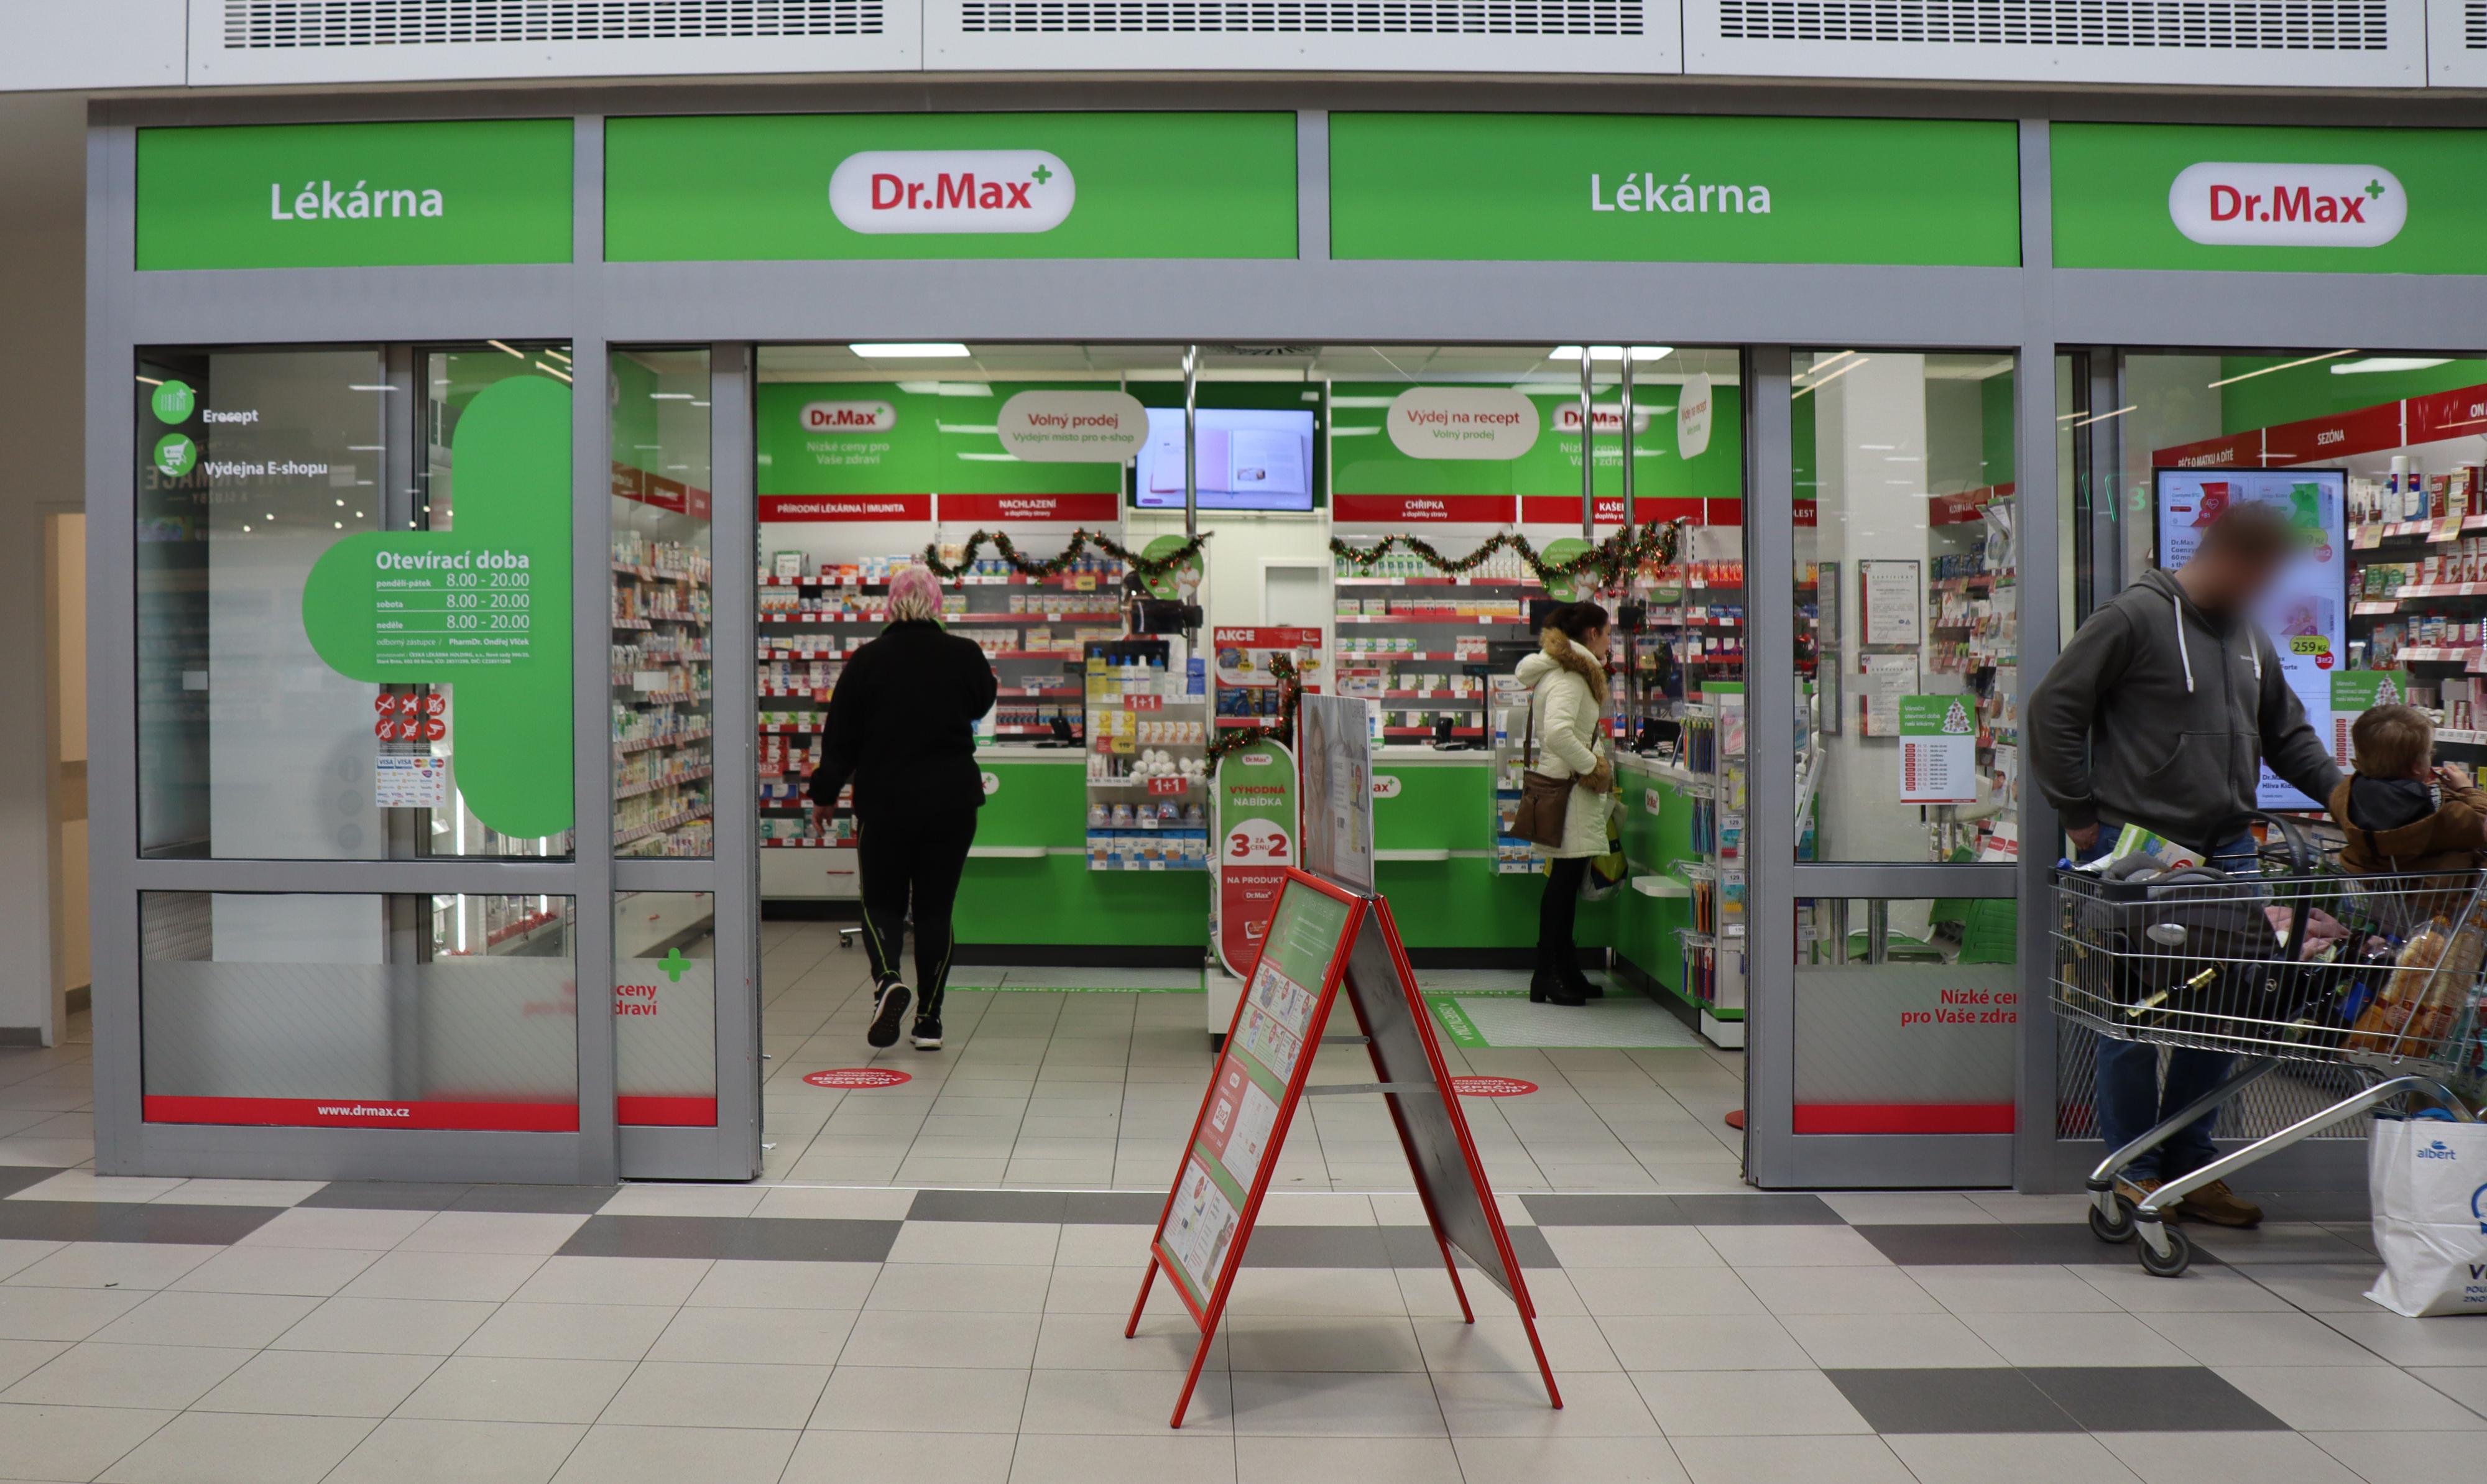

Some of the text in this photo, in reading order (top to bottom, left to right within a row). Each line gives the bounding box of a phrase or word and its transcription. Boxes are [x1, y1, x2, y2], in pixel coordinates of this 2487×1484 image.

[271, 181, 443, 219] Lékárna
[1592, 173, 1771, 213] Lékárna
[2470, 403, 2485, 417] ON
[1028, 413, 1119, 429] Volný prodej
[1407, 410, 1520, 426] Výdej na recept
[1081, 435, 1098, 443] pro
[1100, 432, 1134, 443] e-shop
[1433, 429, 1495, 441] Volný prodej
[2317, 430, 2345, 445] SEZÓNA
[841, 443, 867, 453] ceny
[870, 443, 890, 453] pro
[2197, 452, 2215, 467] MATKU
[205, 461, 328, 479] Výdejna E-shopu
[777, 502, 905, 513] PŘÍRODNÍ LÉKÁRNA IMUNITA
[999, 499, 1056, 509] NACHLAZENÍ
[1405, 499, 1444, 509] CHŘIPKA
[376, 550, 530, 569] Otevírací doba
[376, 579, 431, 588] pondělí-pátek
[446, 573, 477, 586] 8.00
[490, 573, 530, 586] 20.00
[376, 600, 404, 608] sobota
[446, 594, 477, 607] 8.00
[490, 594, 530, 607] 20.00
[376, 621, 404, 629] neděle
[446, 615, 477, 629] 8.00
[490, 615, 530, 629] 20.00
[376, 638, 405, 647] odborný
[406, 638, 436, 647] zástupce
[484, 638, 508, 647] Ondřej
[510, 638, 530, 646] Vlček
[1216, 630, 1255, 642] AKCE
[2293, 642, 2316, 652] 259
[1130, 696, 1155, 709] 1+1
[1155, 779, 1179, 792] 1+1
[1230, 785, 1286, 795] VÝHODNÁ
[1234, 795, 1282, 806] NABÍDKA
[1230, 833, 1288, 857] 3 2
[617, 985, 657, 1000] ceny
[1941, 989, 1990, 1004] Nízké
[1901, 1011, 1931, 1027] pro
[1935, 1008, 1975, 1023] Vaše
[318, 1105, 410, 1117] www.drmax.cz
[2417, 1150, 2456, 1160] albert
